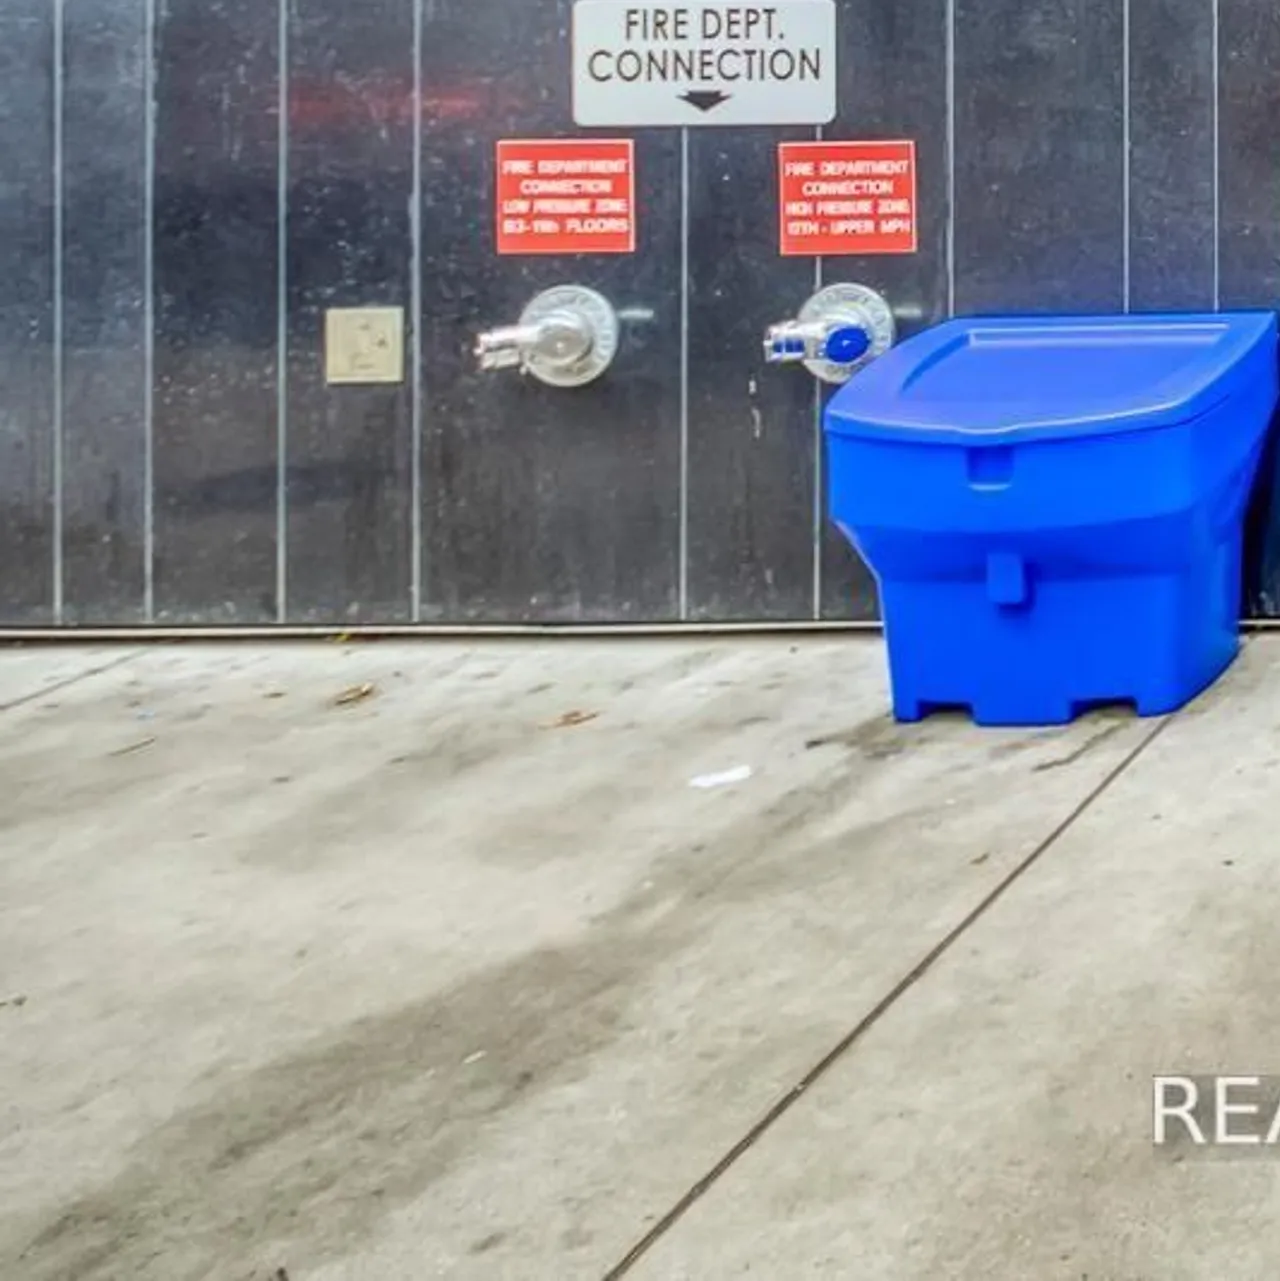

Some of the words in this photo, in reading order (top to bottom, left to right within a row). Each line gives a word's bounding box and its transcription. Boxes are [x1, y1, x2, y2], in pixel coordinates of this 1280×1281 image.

[624, 8, 690, 41] FIRE
[701, 7, 785, 41] DEPT.
[587, 47, 822, 83] CONNECTION
[801, 180, 893, 197] CONNECTION
